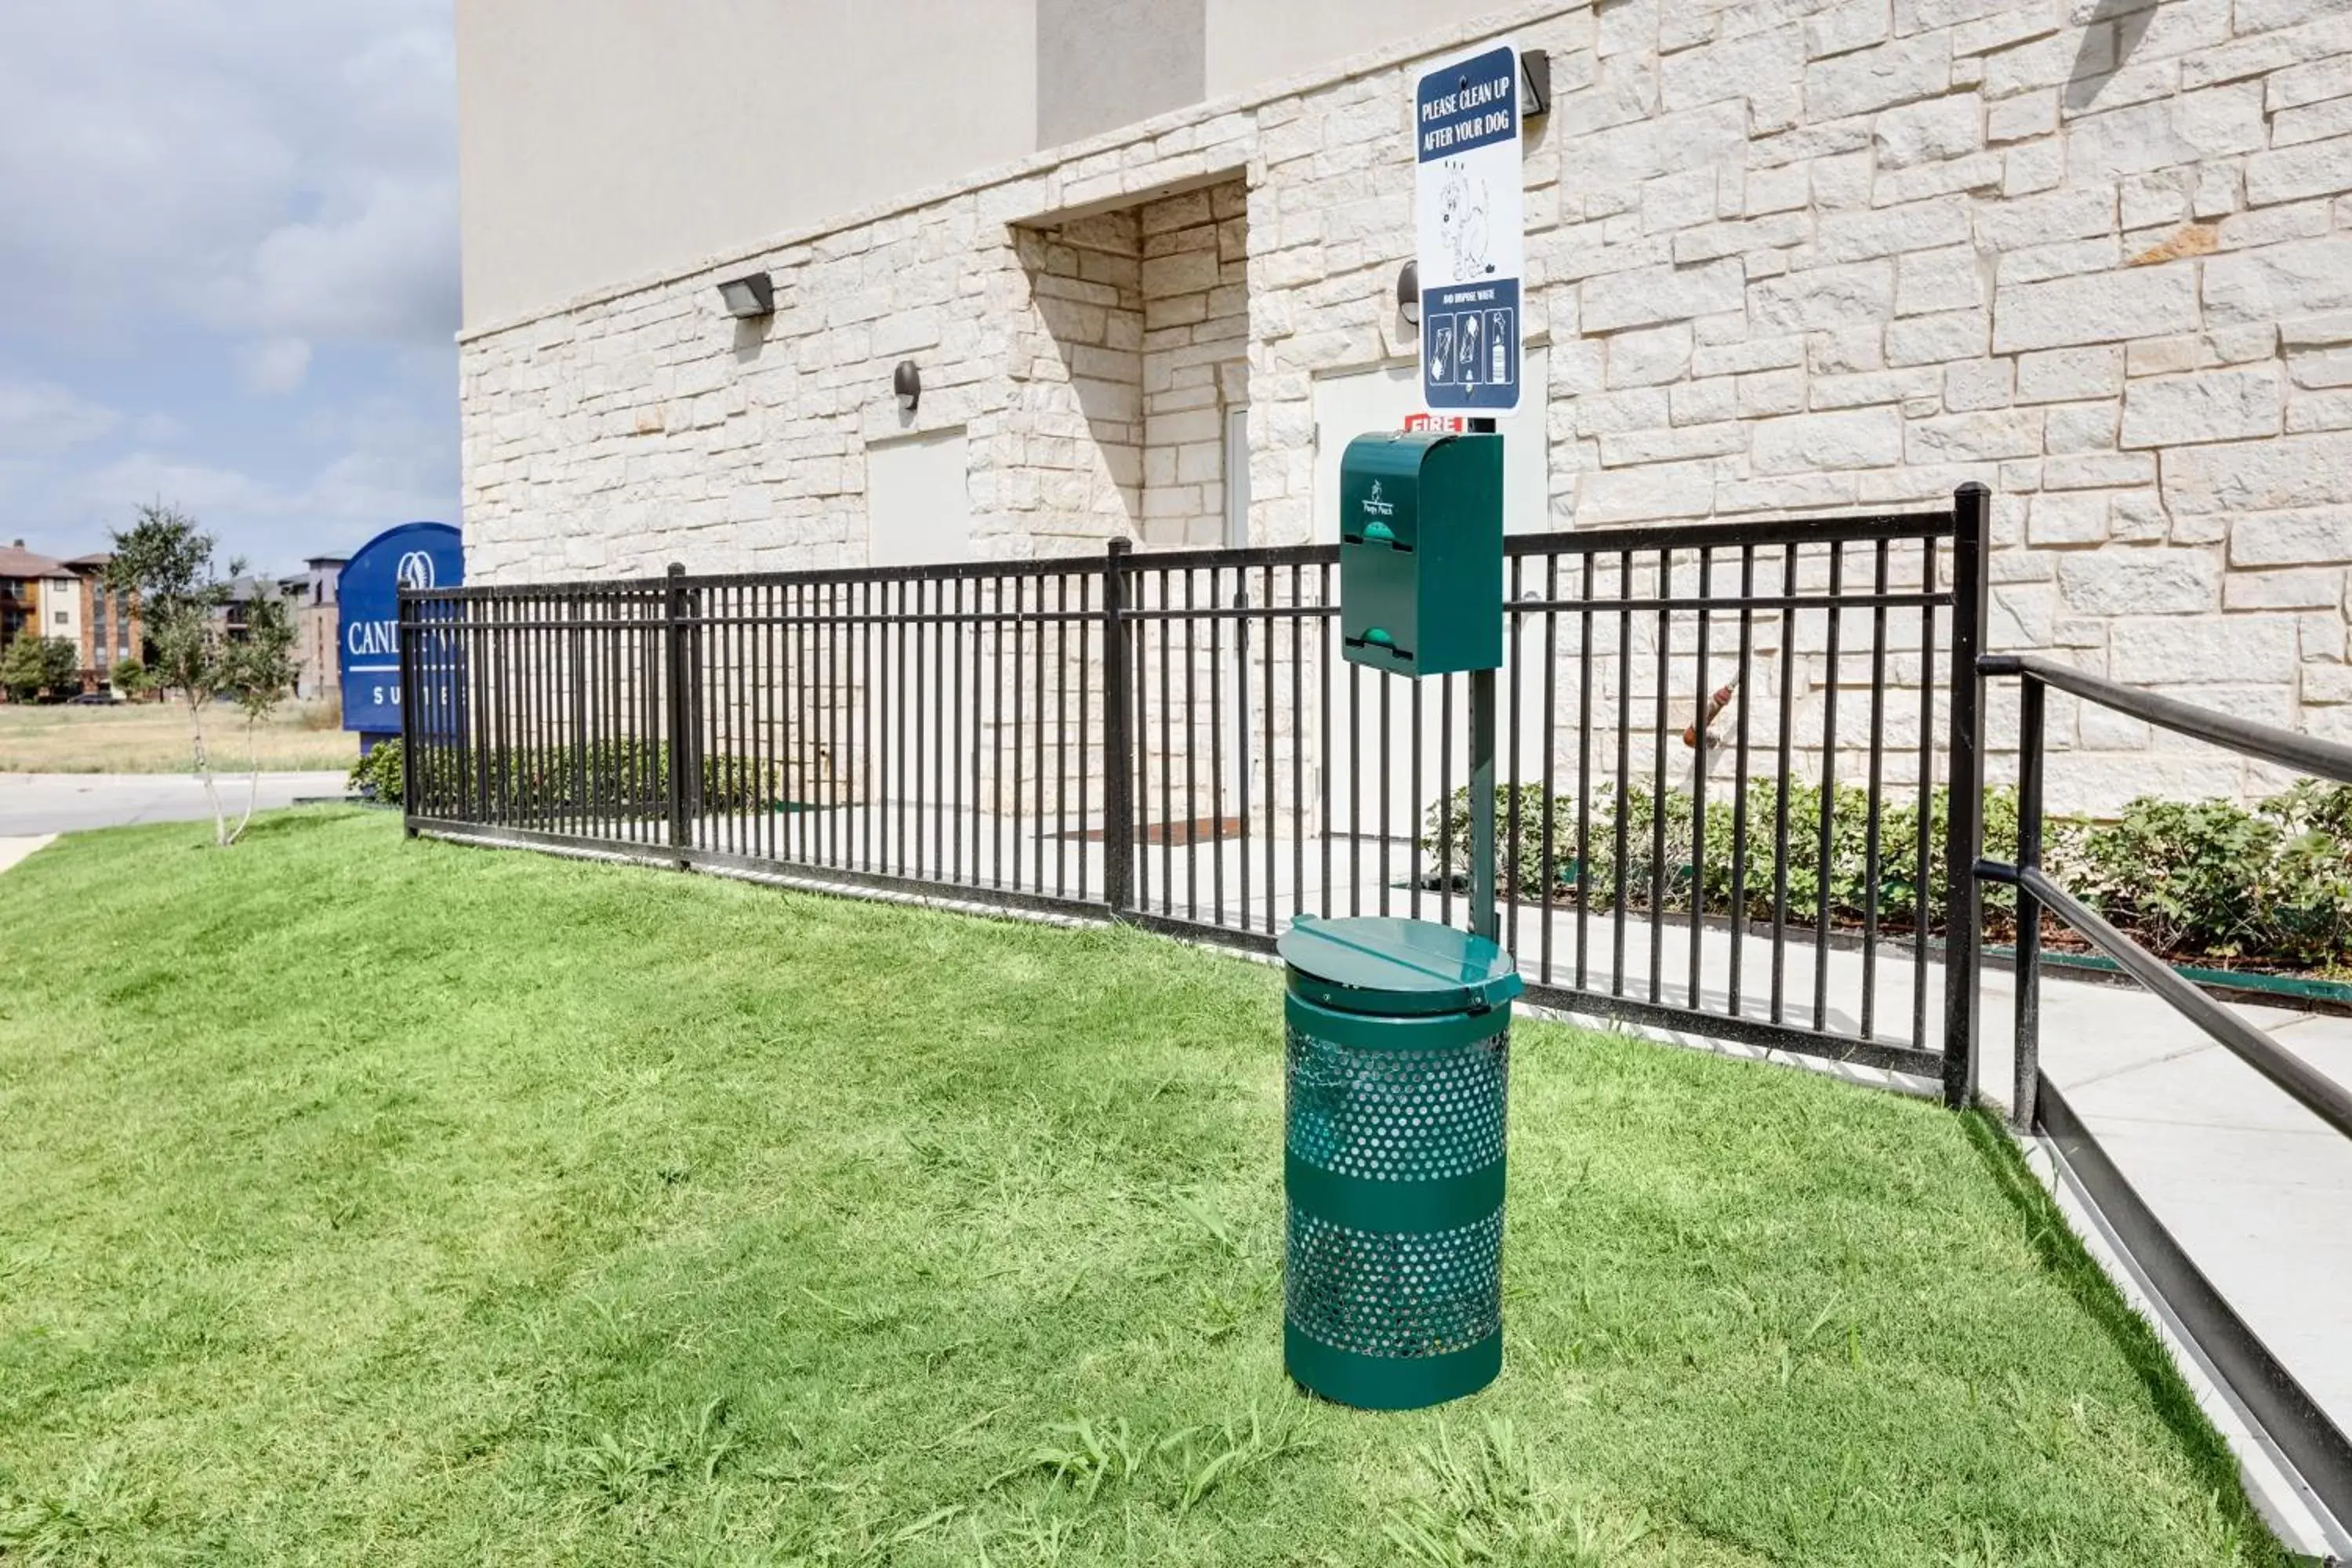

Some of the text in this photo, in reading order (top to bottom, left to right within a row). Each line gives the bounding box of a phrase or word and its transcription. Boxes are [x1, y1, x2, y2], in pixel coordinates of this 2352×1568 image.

[1422, 76, 1510, 122] PLEASE CLEAN UP
[1424, 108, 1509, 151] AFTER YOUR DOG
[1412, 416, 1456, 432] FIRE
